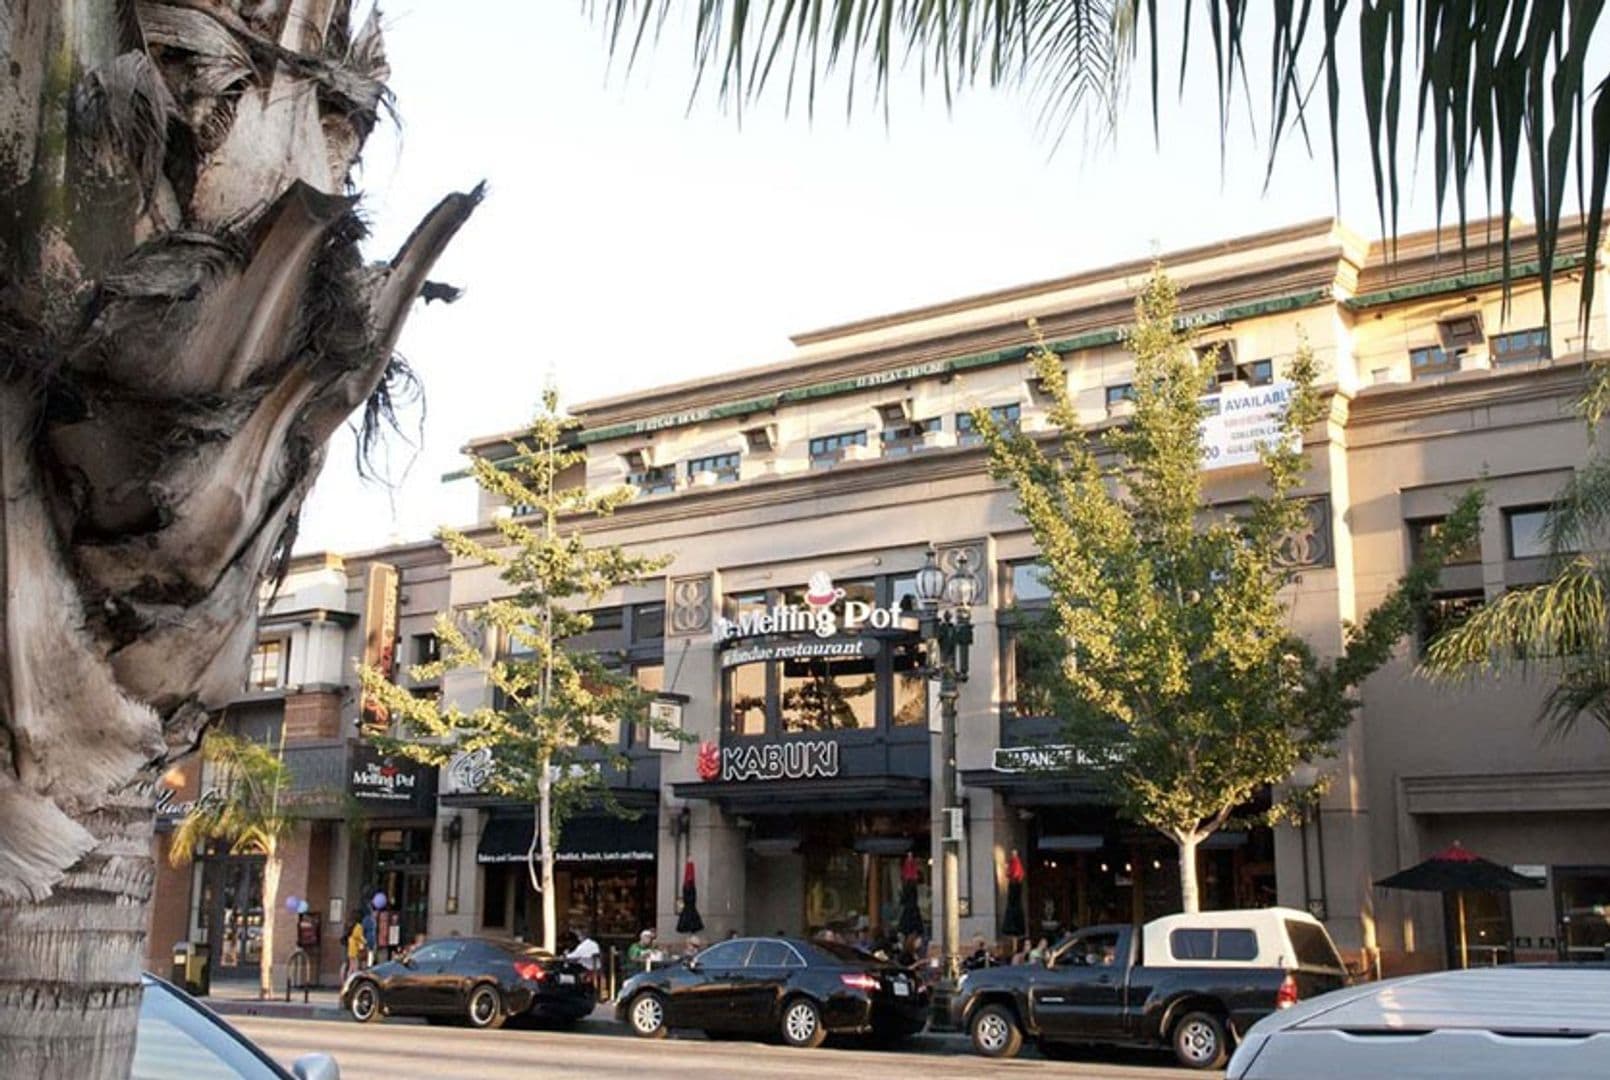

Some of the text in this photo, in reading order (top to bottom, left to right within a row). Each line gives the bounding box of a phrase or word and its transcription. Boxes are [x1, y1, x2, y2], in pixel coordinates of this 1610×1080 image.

[738, 603, 837, 637] Melting
[844, 600, 902, 629] Pot
[774, 639, 863, 658] restaurant
[722, 741, 838, 780] KABUKI
[353, 771, 415, 788] Melting Pot
